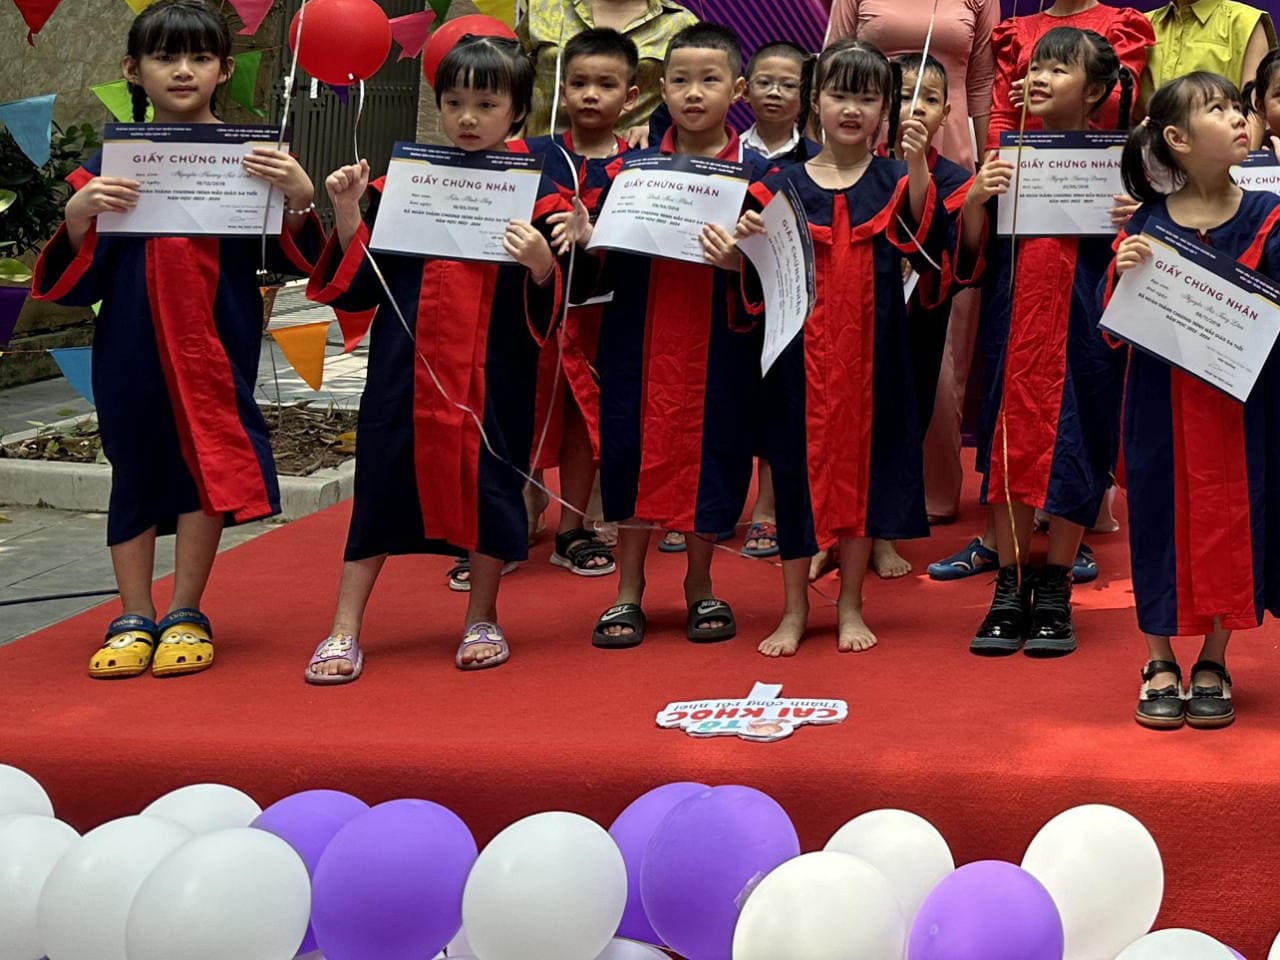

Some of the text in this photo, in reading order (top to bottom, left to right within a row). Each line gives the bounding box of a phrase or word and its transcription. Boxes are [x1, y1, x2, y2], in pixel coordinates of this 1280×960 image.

[132, 153, 164, 164] GIẤY
[170, 152, 217, 164] CHỨNG
[1020, 159, 1044, 169] GIẤY
[1048, 159, 1087, 169] CHỨNG
[412, 174, 438, 185] GIẤY
[442, 177, 482, 190] CHỨNG
[647, 179, 684, 191] CHỨNG
[1155, 259, 1183, 279] GIẤY
[1184, 275, 1224, 303] CHỨNG
[1226, 296, 1260, 322] NHẬN
[777, 707, 839, 719] CAI
